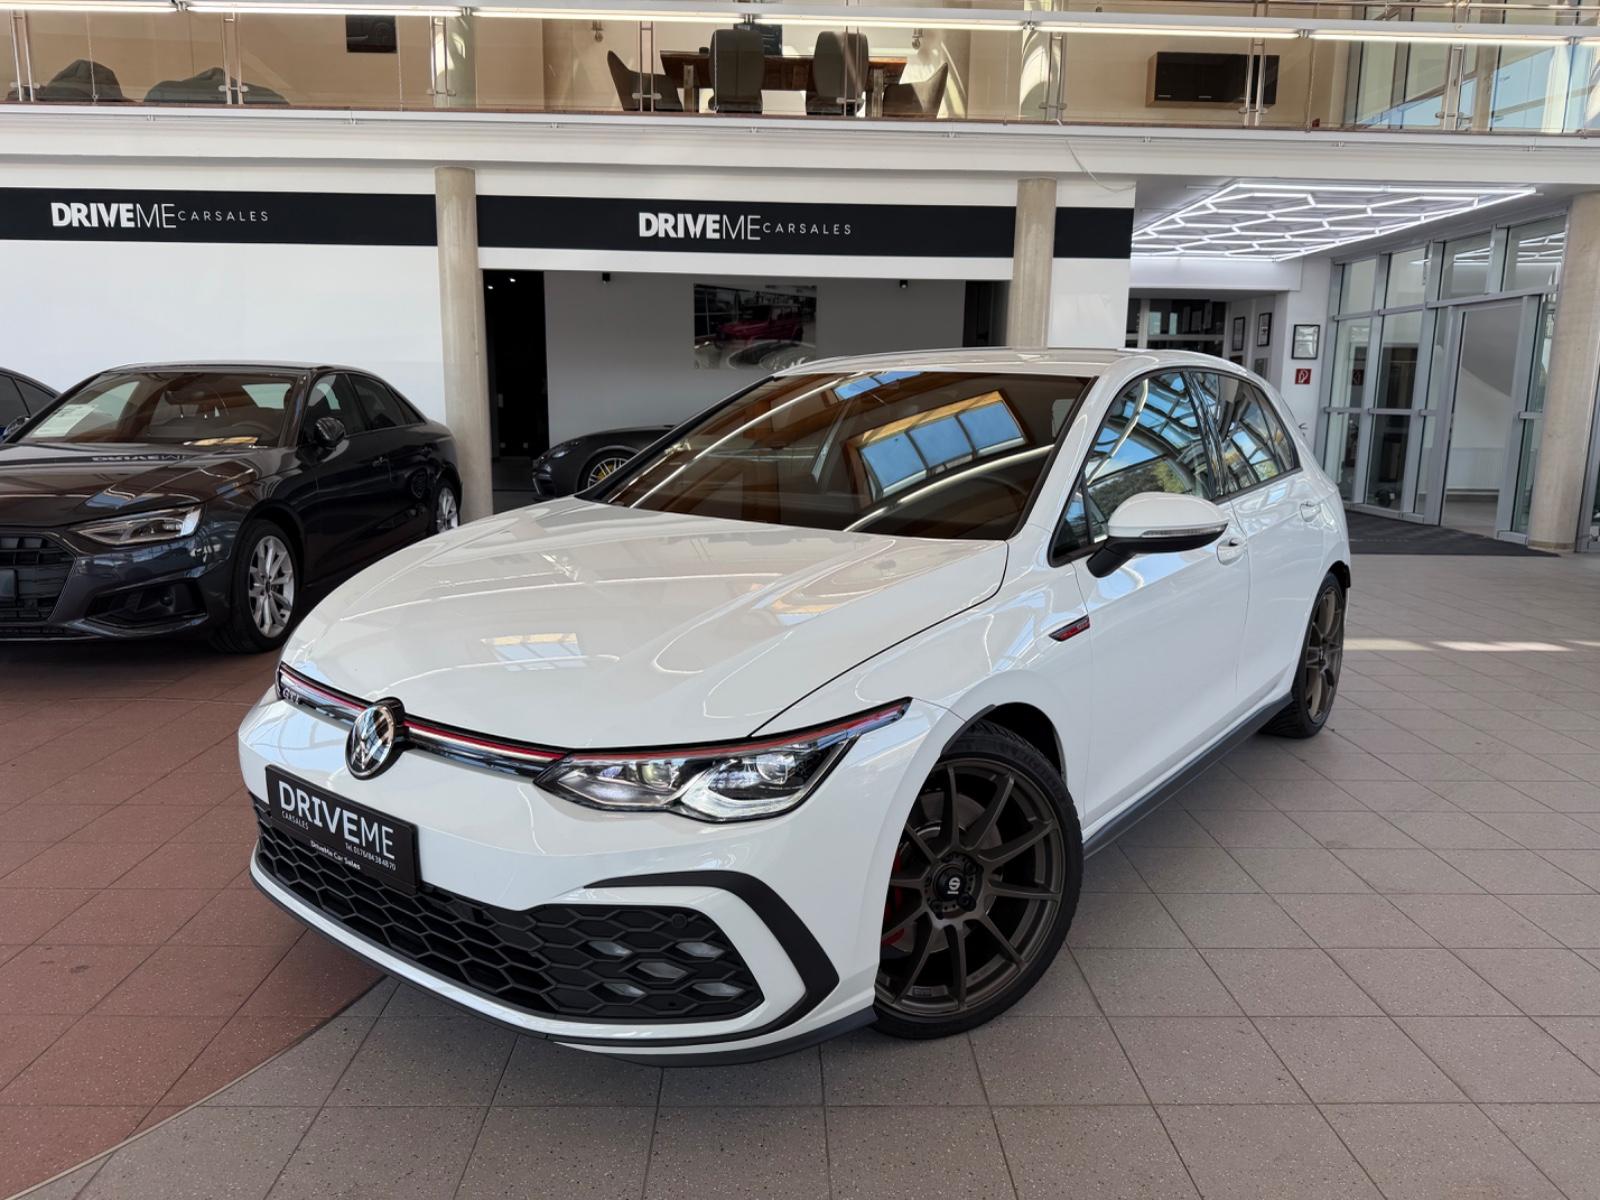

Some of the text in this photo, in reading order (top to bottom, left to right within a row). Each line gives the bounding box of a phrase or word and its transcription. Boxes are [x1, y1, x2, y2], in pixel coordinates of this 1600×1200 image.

[51, 202, 269, 229] DRIVEME CARSALES
[639, 212, 851, 241] DRIVEME CARSALES
[282, 687, 301, 705] GTI
[278, 780, 396, 860] DRIVEME
[281, 810, 309, 831] CARSALES
